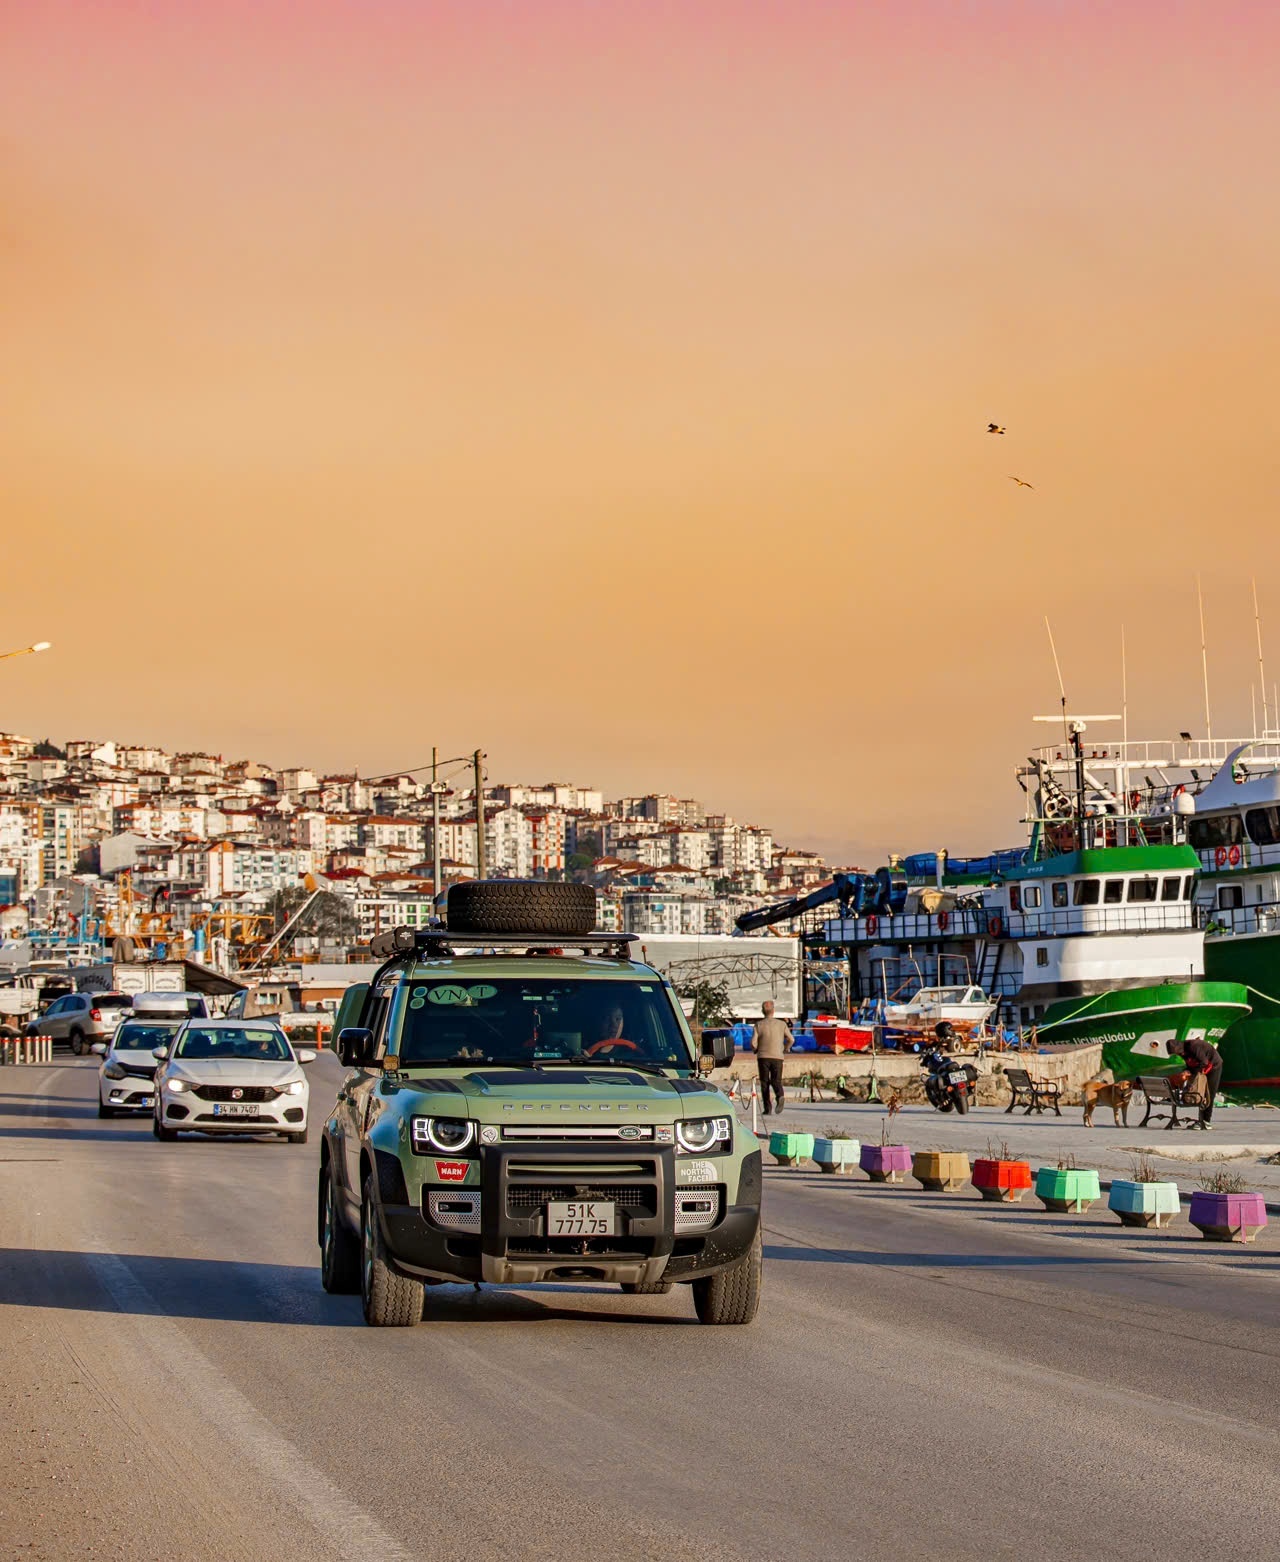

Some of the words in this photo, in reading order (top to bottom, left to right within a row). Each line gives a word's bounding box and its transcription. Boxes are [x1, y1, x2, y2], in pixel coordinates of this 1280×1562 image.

[433, 989, 463, 1000] VN
[441, 1167, 463, 1175] WARN
[567, 1204, 595, 1218] 51K
[555, 1219, 608, 1234] 777.75
